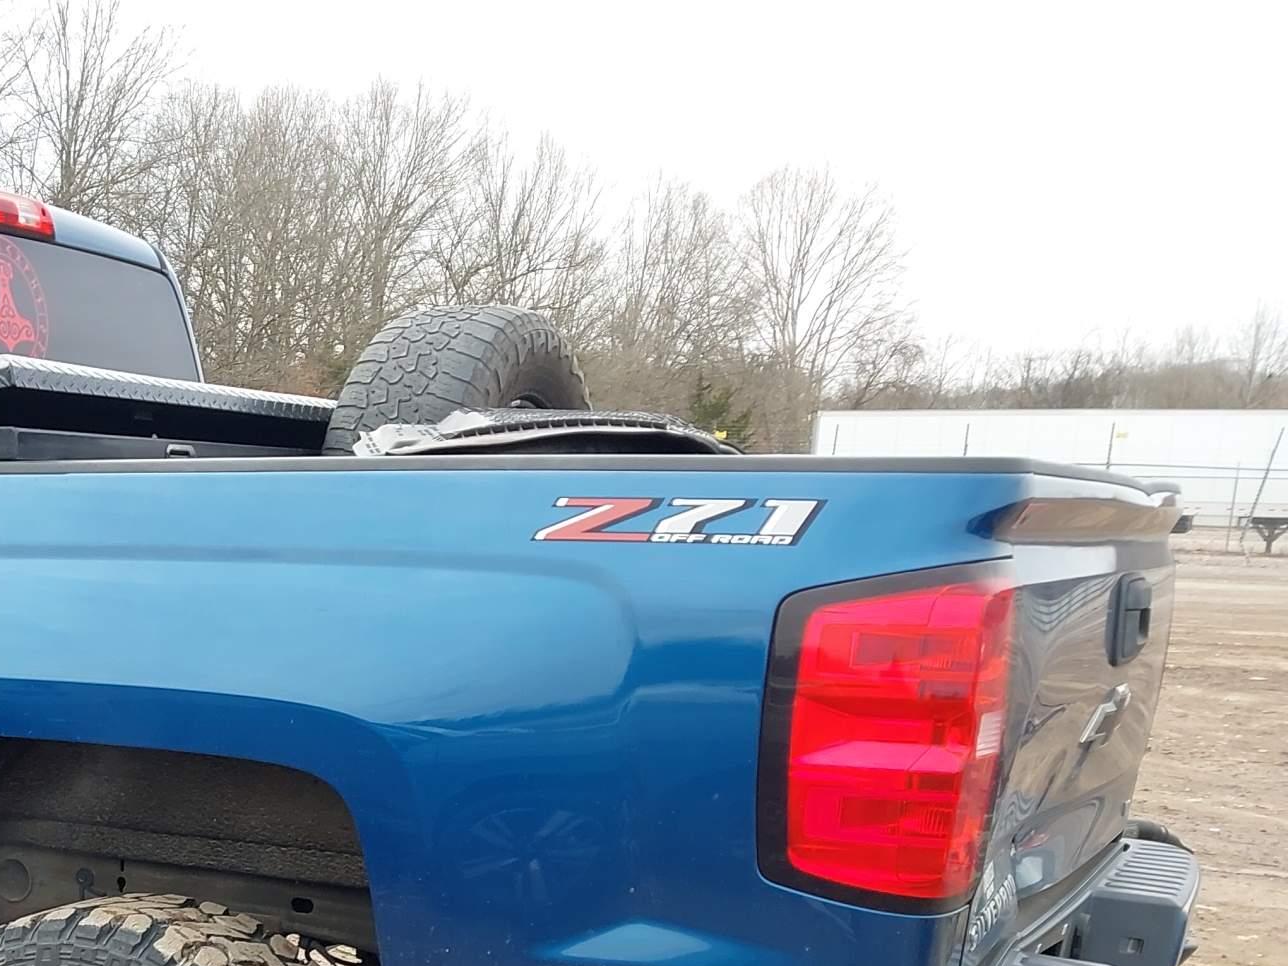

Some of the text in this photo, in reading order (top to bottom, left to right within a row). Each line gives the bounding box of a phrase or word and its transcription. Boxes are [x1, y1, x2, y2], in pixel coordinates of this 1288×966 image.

[530, 497, 828, 543] Z71
[651, 533, 795, 545] OFF ROAD
